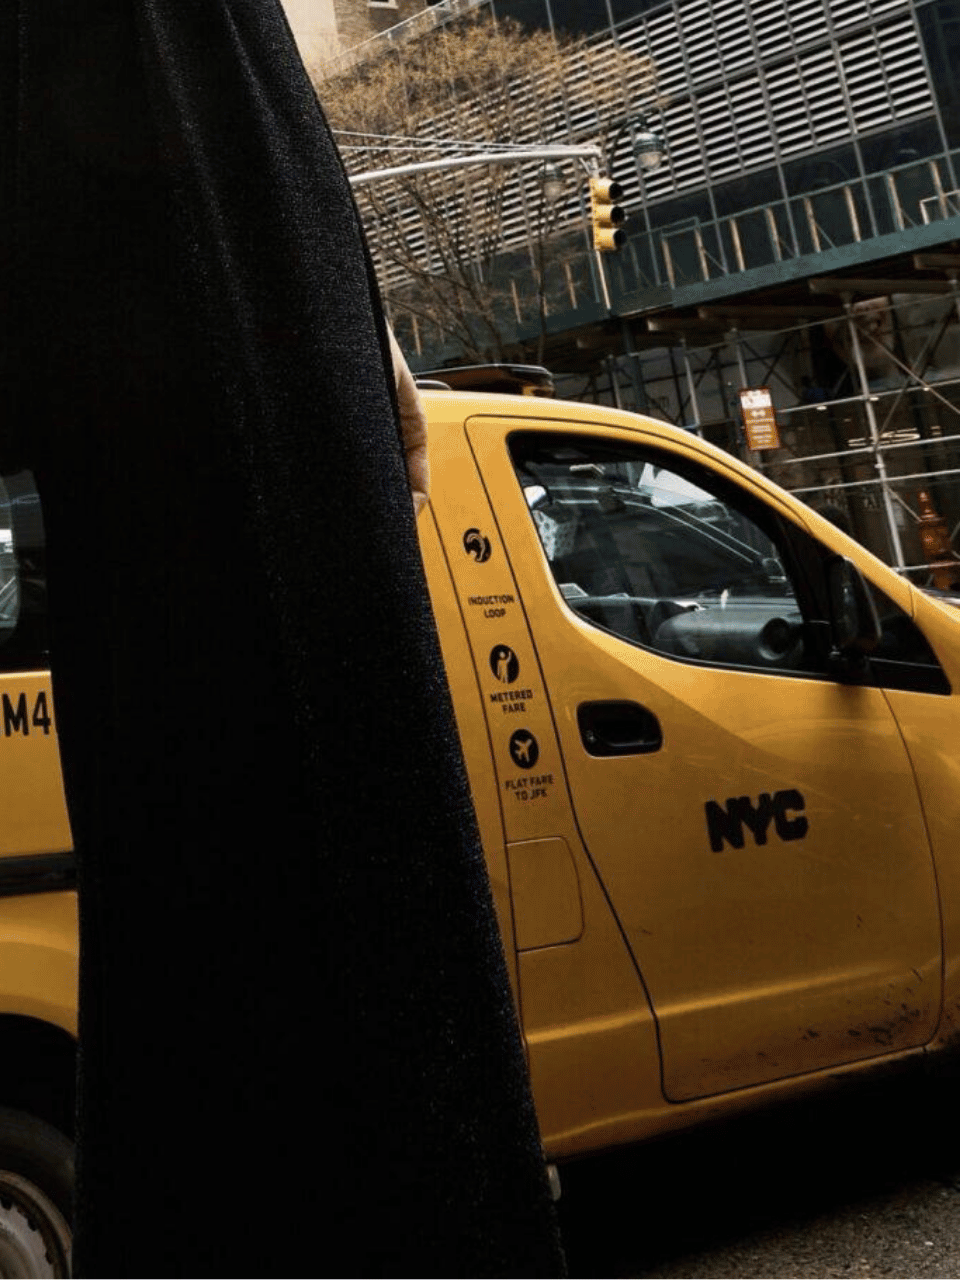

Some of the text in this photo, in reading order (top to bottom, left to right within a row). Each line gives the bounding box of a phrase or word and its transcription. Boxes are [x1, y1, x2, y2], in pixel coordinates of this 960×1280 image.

[467, 594, 514, 606] INDUCTION
[484, 608, 506, 619] LOOP
[490, 689, 533, 702] METERED
[502, 702, 526, 713] FARE
[505, 774, 554, 790] FLAT FARE
[515, 787, 548, 801] TO JFK
[704, 788, 809, 853] NYC
